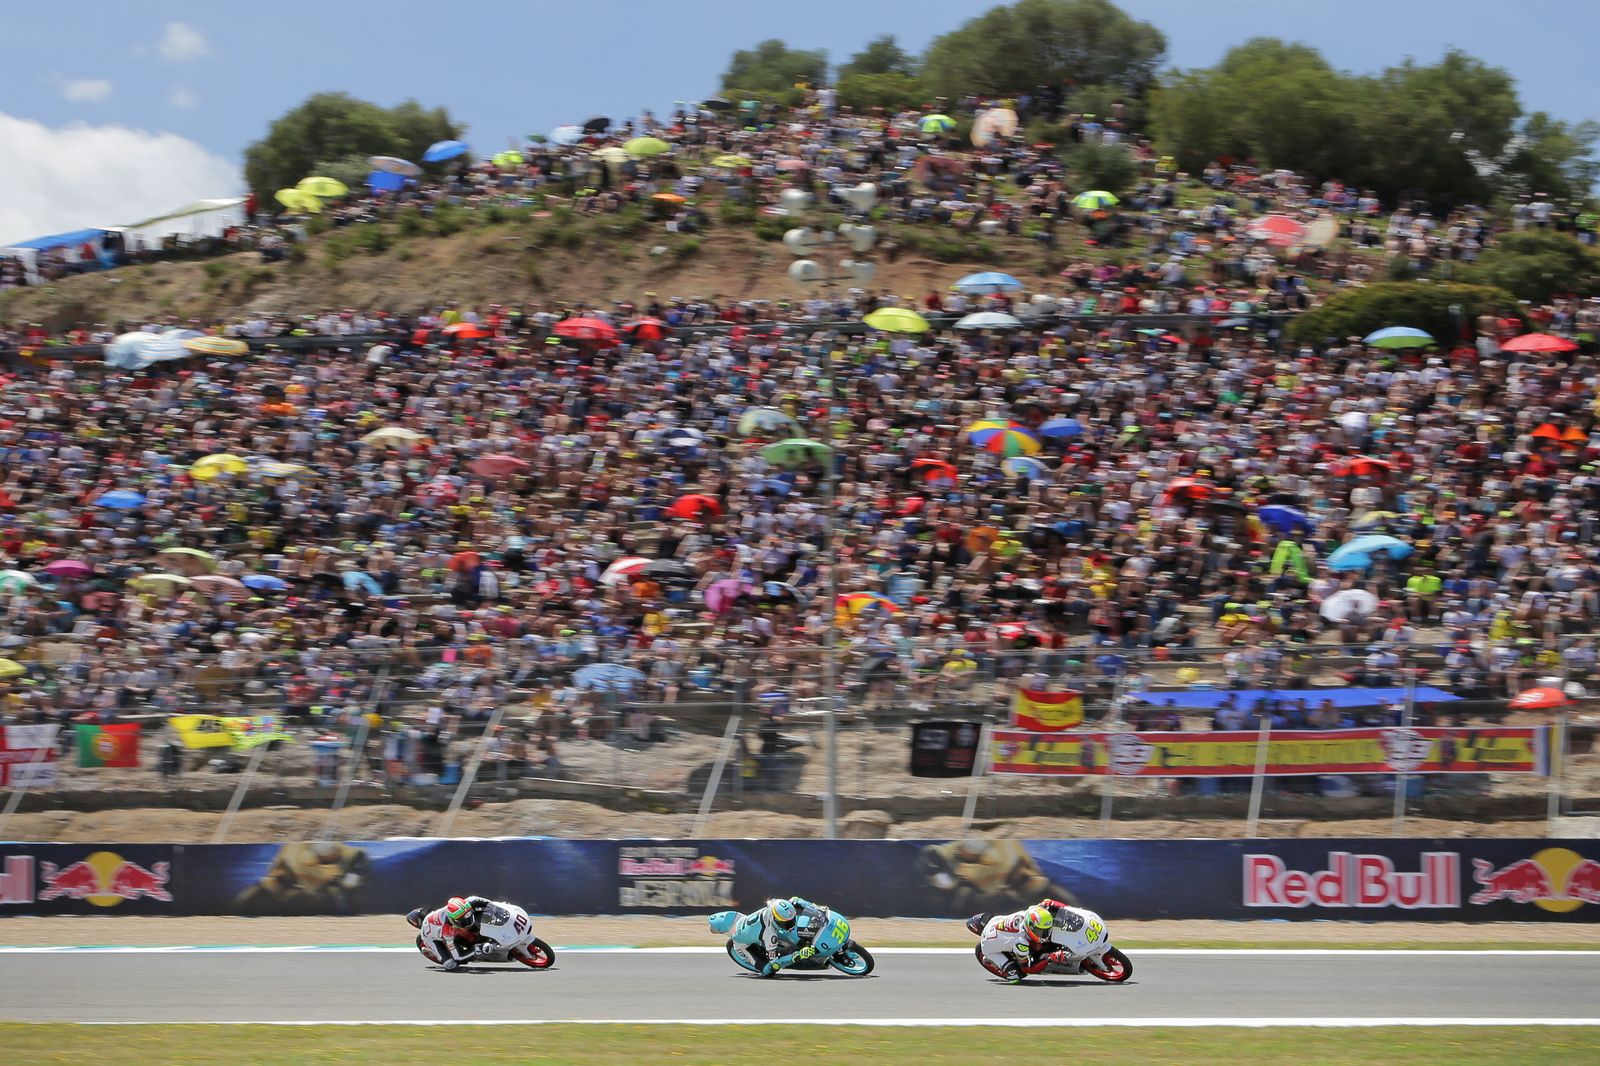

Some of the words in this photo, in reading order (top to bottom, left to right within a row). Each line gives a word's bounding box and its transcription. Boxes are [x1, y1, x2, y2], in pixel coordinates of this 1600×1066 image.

[1243, 853, 1352, 907] Red
[1352, 852, 1460, 908] Bull
[513, 914, 527, 935] 40
[831, 919, 848, 944] 36
[1084, 919, 1103, 944] 42
